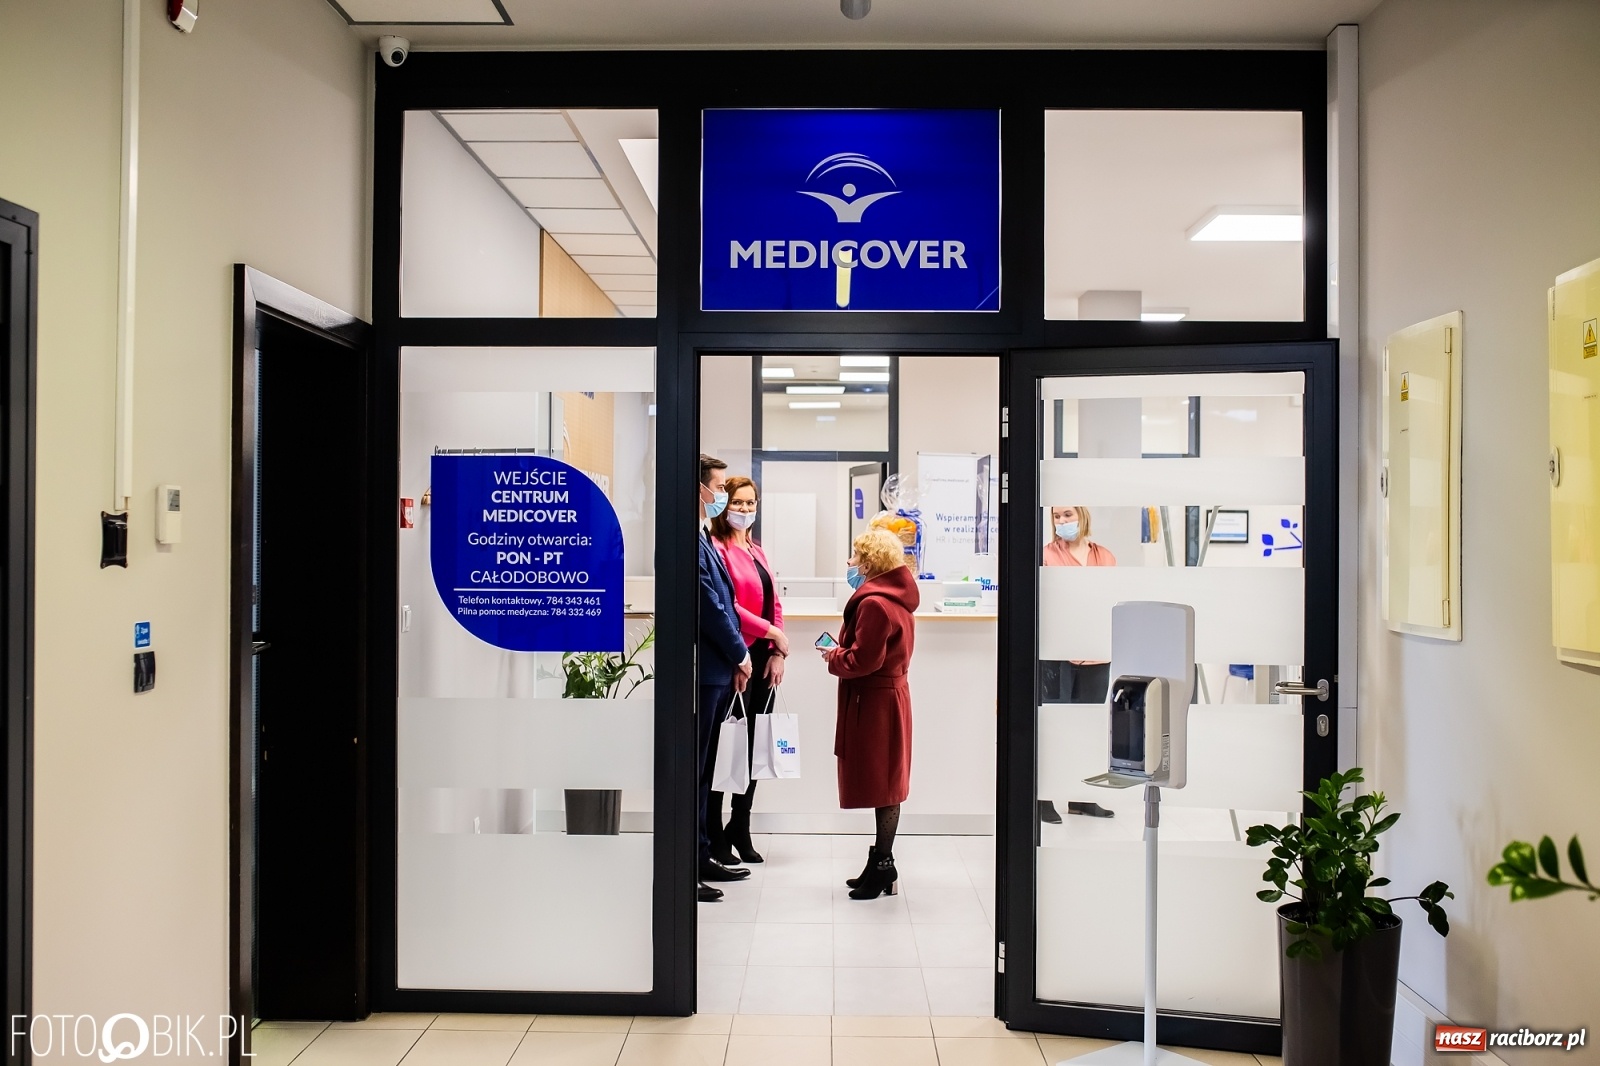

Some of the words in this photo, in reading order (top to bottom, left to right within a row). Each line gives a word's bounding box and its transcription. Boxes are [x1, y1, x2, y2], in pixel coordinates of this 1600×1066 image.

[730, 240, 968, 268] MEDICOVER
[494, 469, 566, 485] WEJŚCIE
[492, 491, 568, 503] CENTRUM
[483, 510, 577, 522] MEDICOVER
[468, 533, 524, 547] Godziny
[528, 533, 591, 545] otwarcia:
[497, 552, 530, 564] PON
[544, 552, 563, 564] PT
[471, 571, 588, 583] CAŁODOBOWO
[459, 596, 489, 604] Telefon
[566, 597, 582, 605] 343
[584, 597, 600, 605] 461
[508, 608, 549, 616] medyczna:
[569, 608, 583, 616] 332
